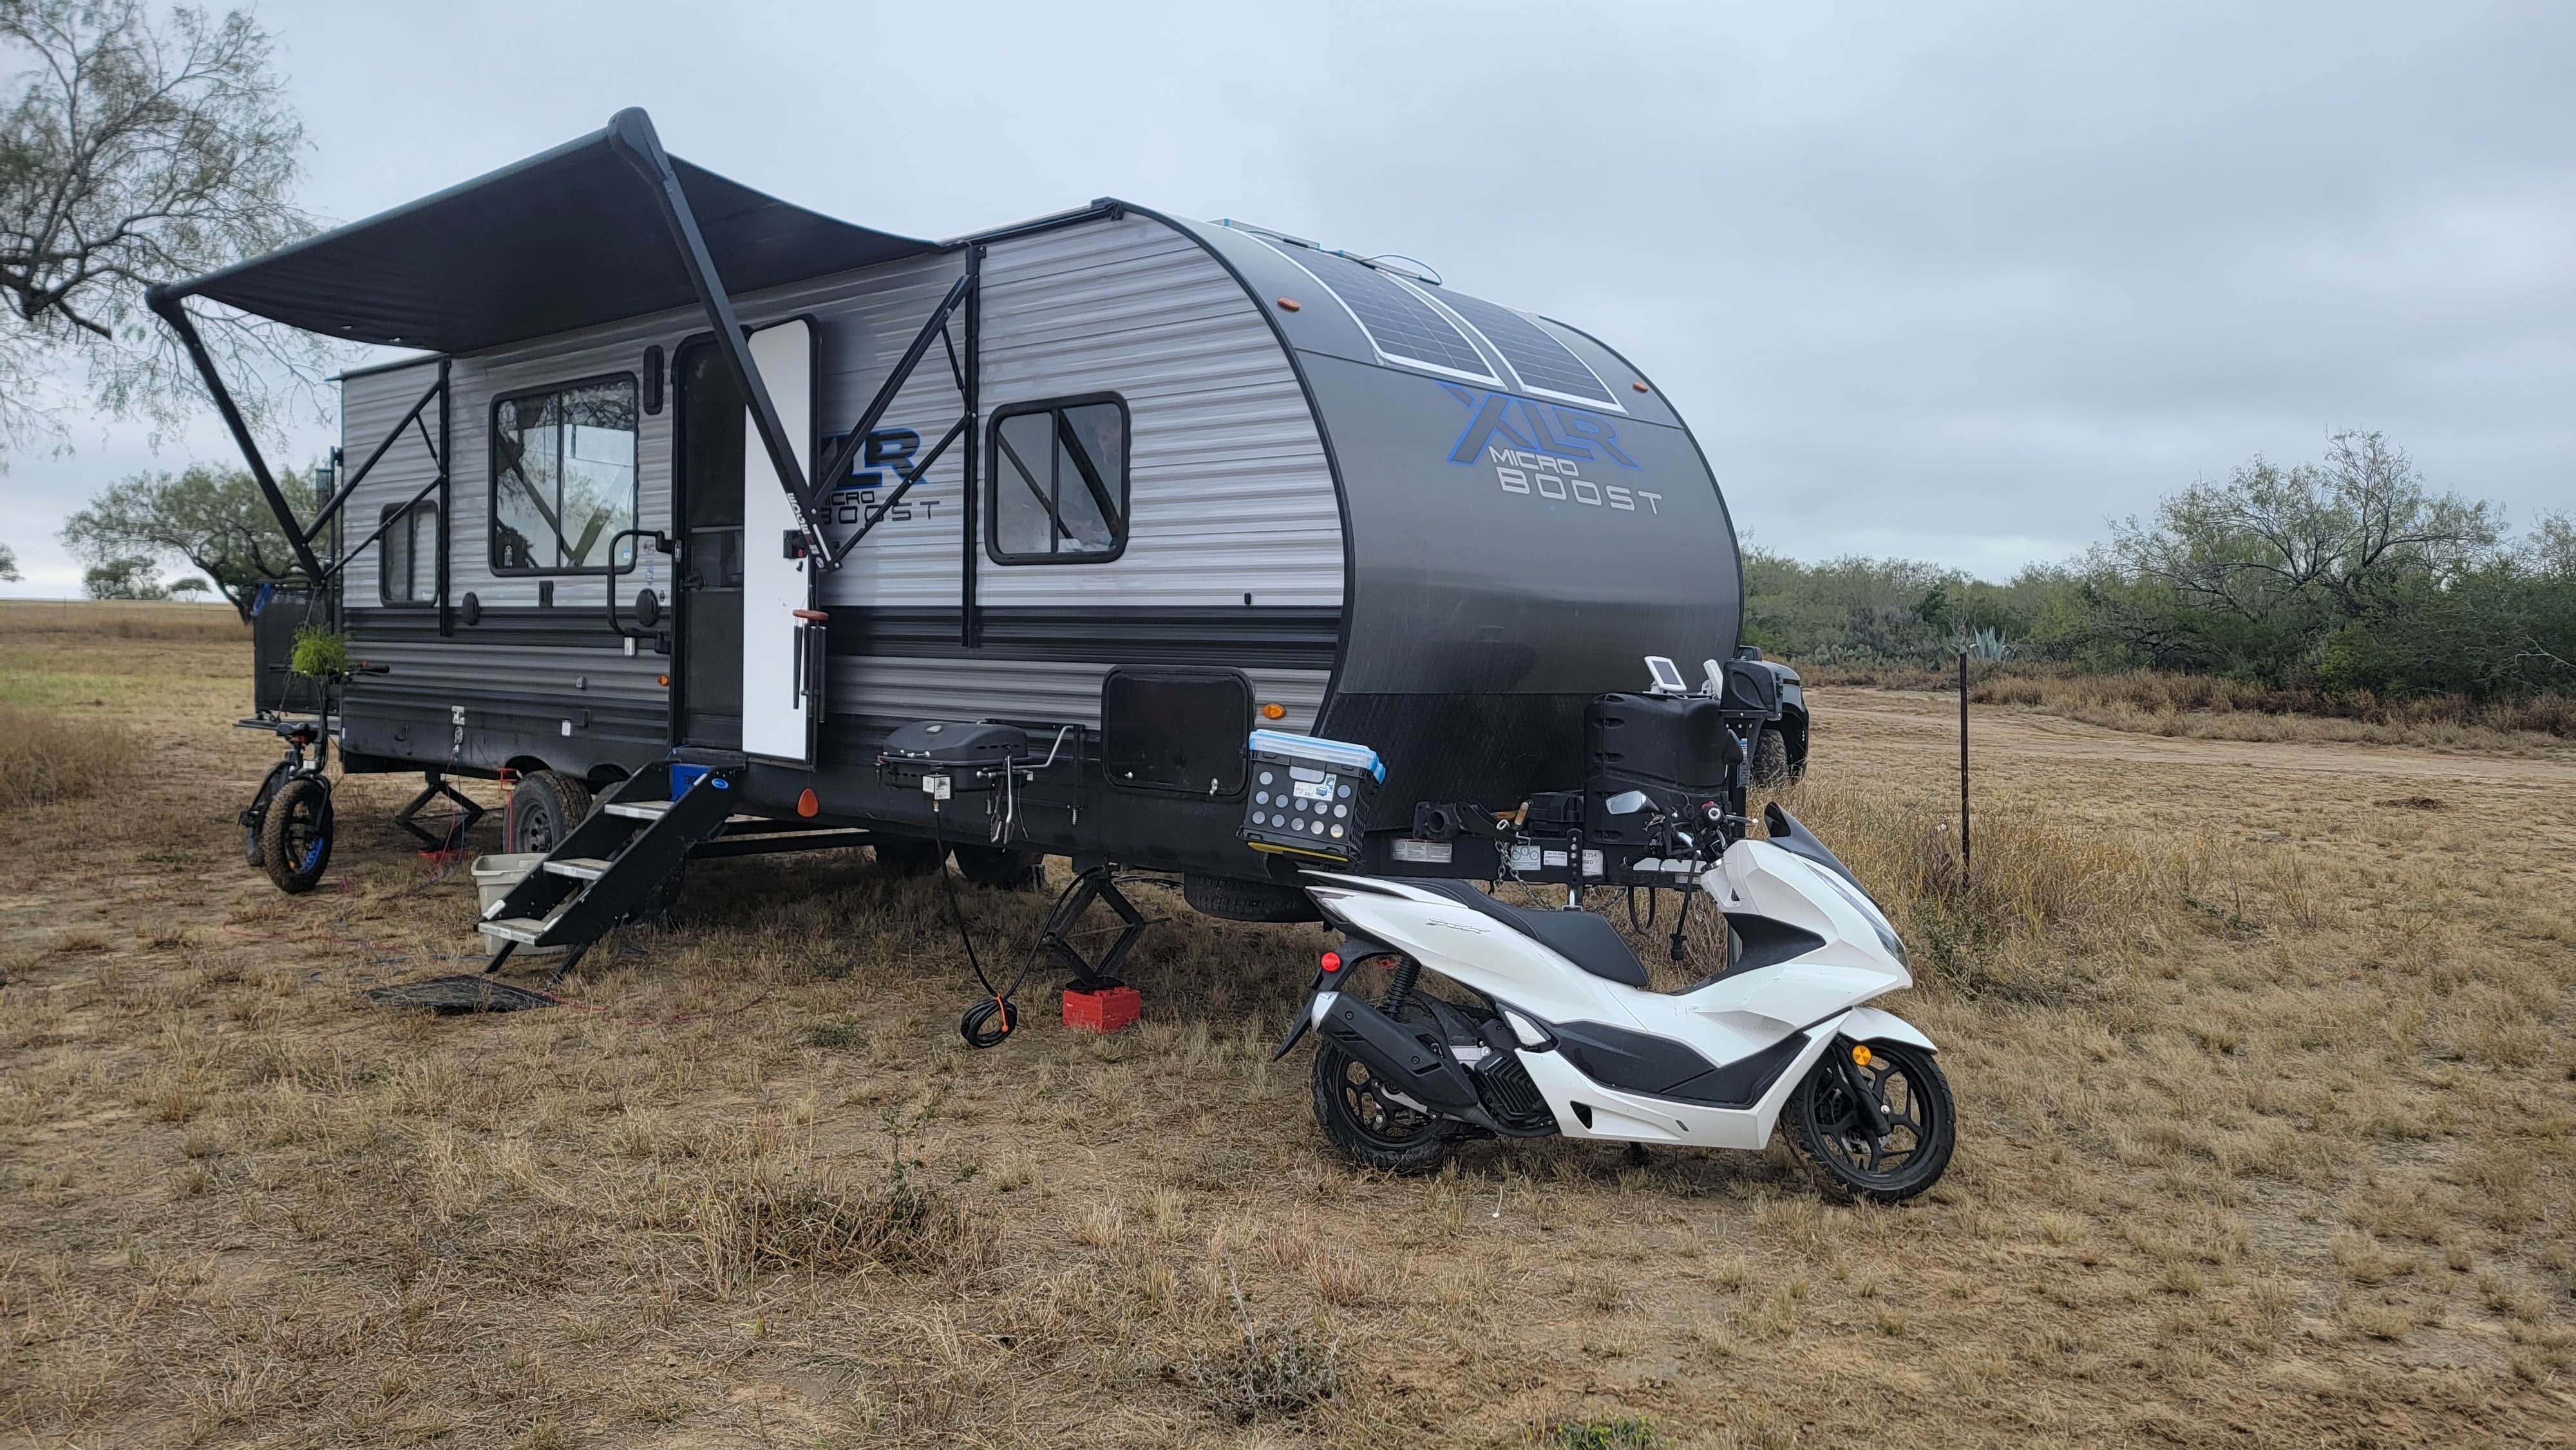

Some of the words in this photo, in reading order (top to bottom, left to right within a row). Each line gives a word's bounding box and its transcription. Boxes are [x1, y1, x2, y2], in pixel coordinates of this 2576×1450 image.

[1434, 381, 1644, 471] XLR
[821, 428, 928, 491] LR
[1488, 446, 1579, 477] MICRO
[1495, 466, 1662, 515] BOOST
